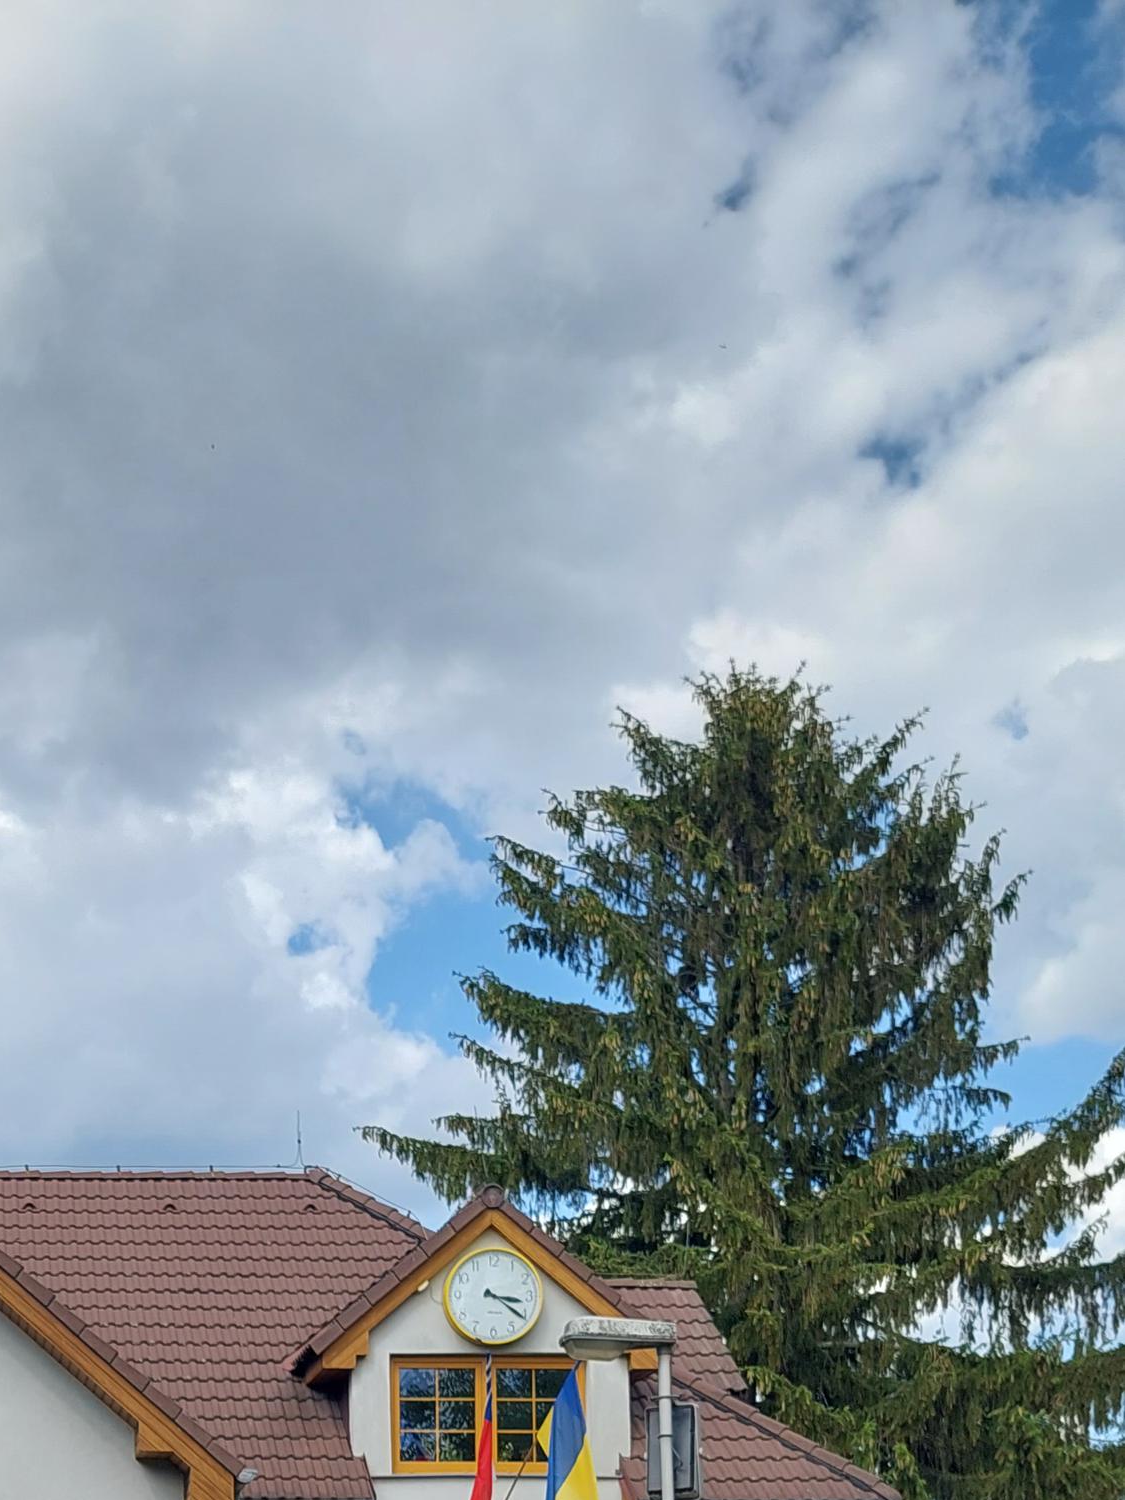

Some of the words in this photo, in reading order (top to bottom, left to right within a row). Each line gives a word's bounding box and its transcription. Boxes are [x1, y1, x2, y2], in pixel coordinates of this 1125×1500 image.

[471, 1260, 479, 1272] 11
[489, 1256, 499, 1267] 12
[458, 1272, 469, 1284] 10
[521, 1272, 531, 1285] 2
[454, 1289, 461, 1300] 9
[526, 1290, 533, 1302] 3
[458, 1310, 467, 1320] 8
[473, 1320, 479, 1332] 7
[507, 1321, 515, 1333] 5
[489, 1326, 497, 1339] 6
